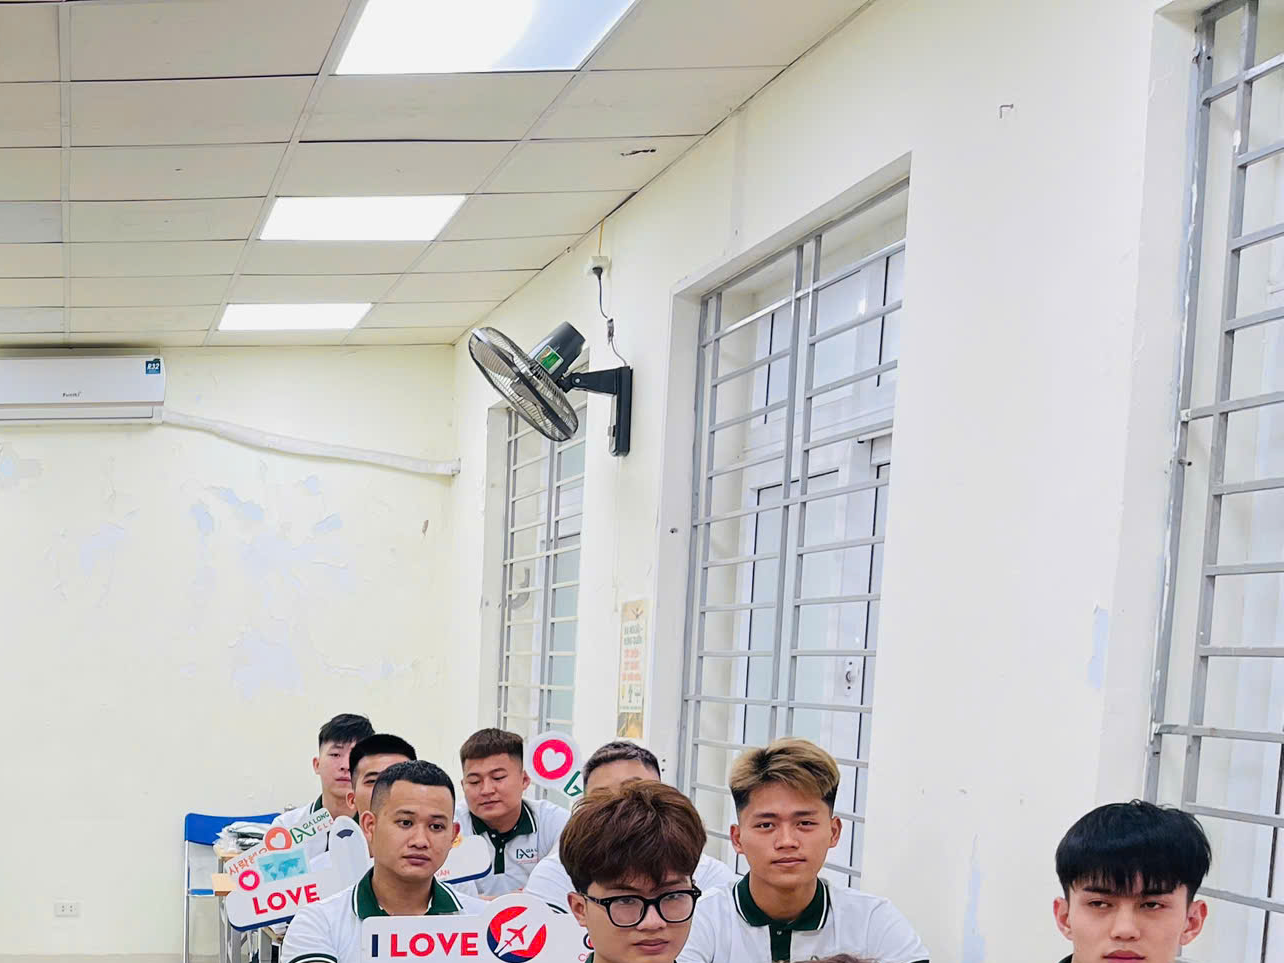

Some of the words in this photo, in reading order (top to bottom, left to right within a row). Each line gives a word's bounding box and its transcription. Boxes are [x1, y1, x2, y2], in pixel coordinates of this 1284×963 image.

[252, 883, 320, 915] LOVE
[371, 934, 379, 957] I
[390, 932, 479, 957] LOVE
